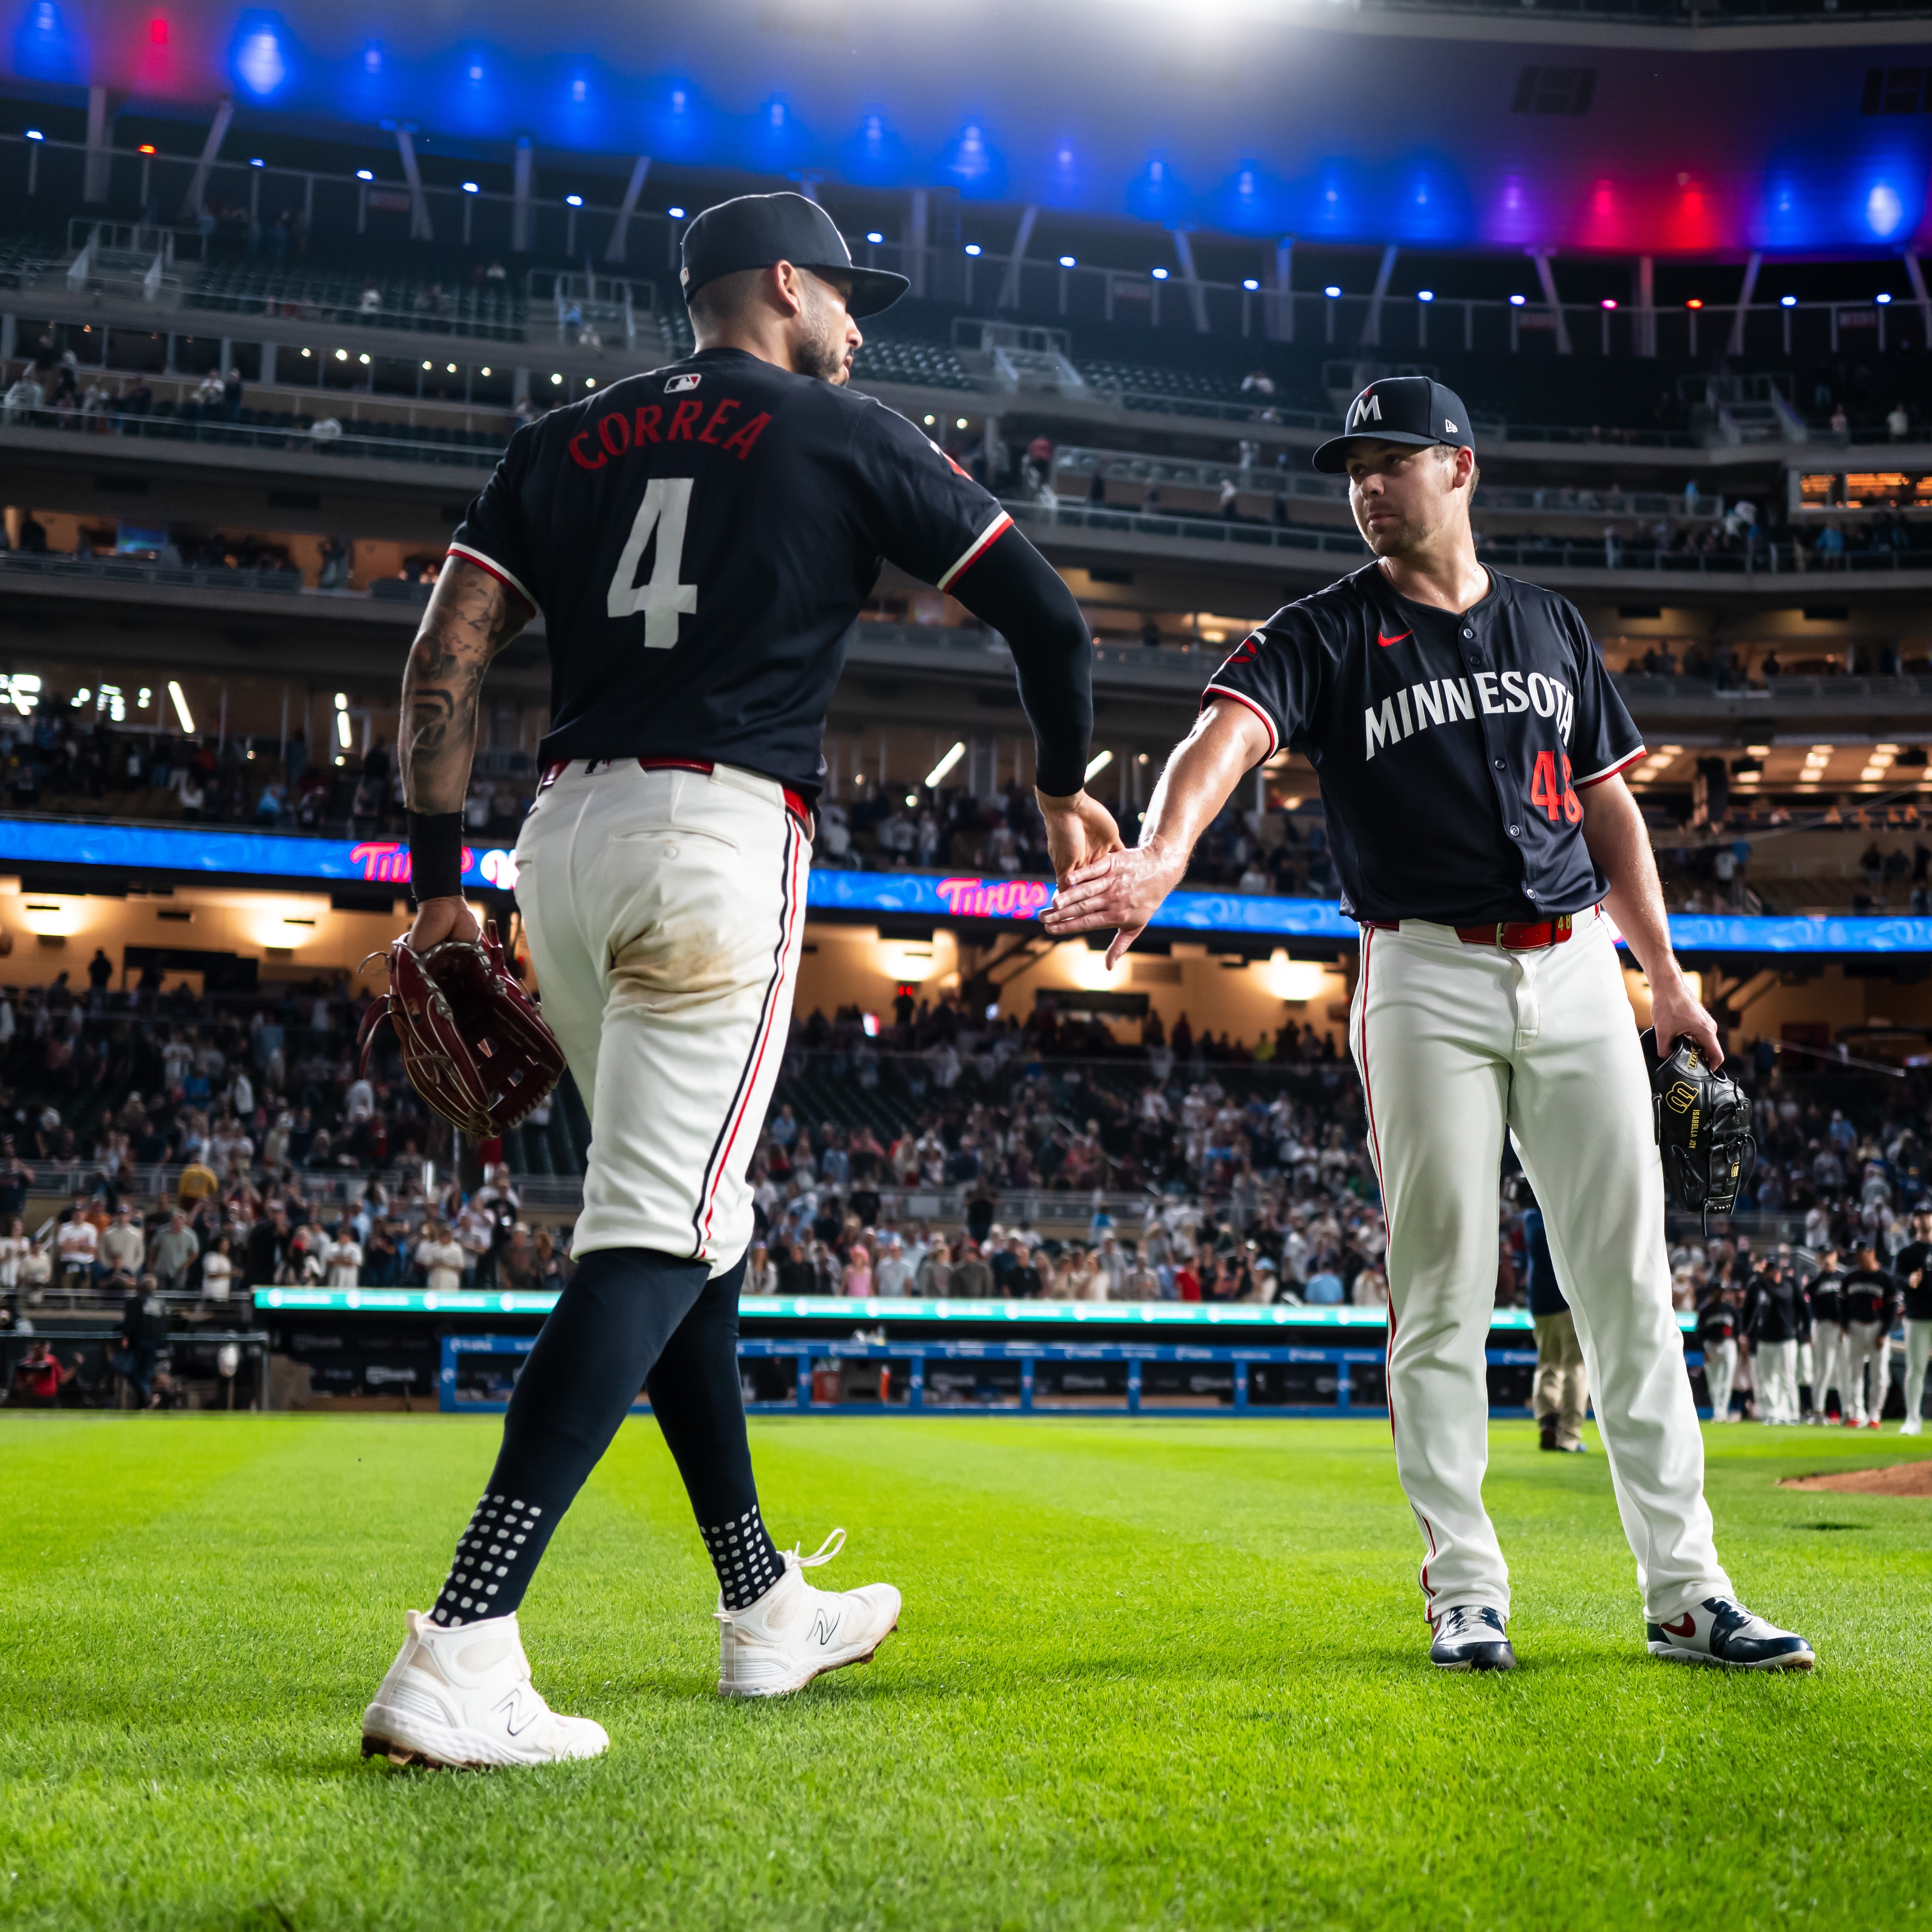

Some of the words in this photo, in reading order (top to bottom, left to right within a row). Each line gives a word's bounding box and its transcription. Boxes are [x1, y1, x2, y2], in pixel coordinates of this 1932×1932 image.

[569, 399, 772, 469] CORREA
[607, 478, 698, 649] 4
[1365, 671, 1575, 760] MINNESOTA
[1530, 751, 1582, 824] 48
[1557, 914, 1571, 931] 48
[1691, 1109, 1700, 1138] ISABELLA
